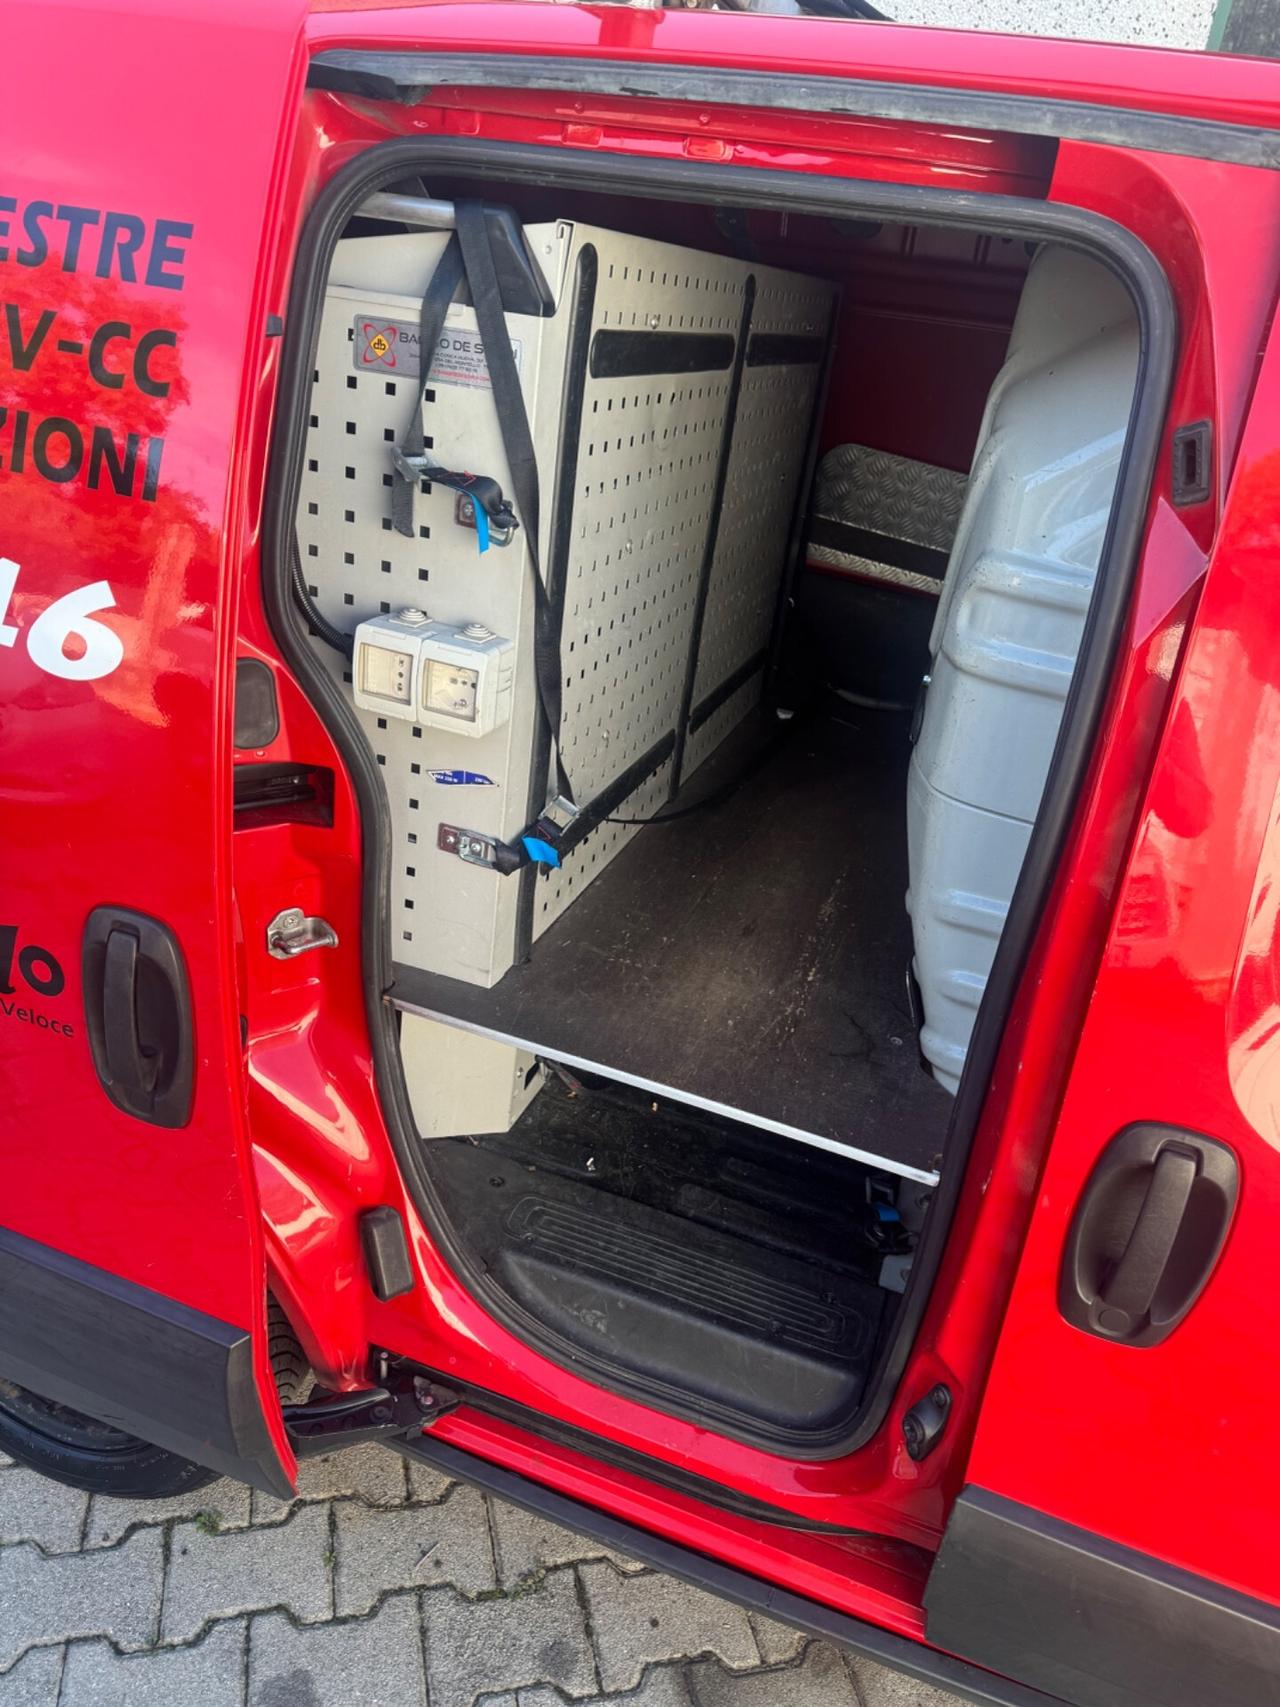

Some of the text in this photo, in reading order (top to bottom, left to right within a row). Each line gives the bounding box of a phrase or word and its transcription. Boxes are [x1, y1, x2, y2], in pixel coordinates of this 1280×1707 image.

[4, 303, 178, 398] V-CC
[453, 340, 471, 353] DE
[0, 998, 74, 1038] Veloce
